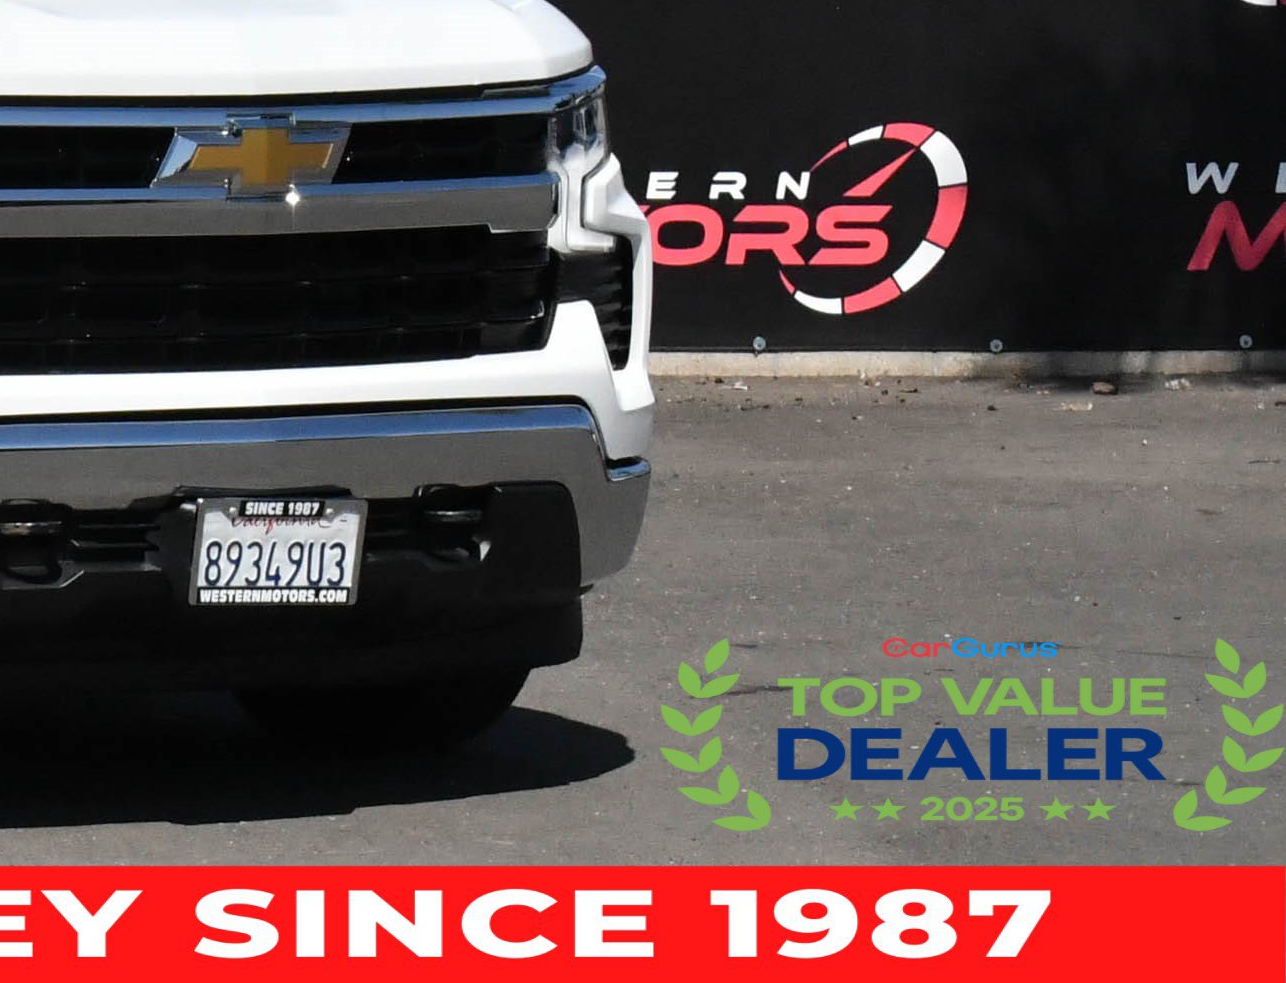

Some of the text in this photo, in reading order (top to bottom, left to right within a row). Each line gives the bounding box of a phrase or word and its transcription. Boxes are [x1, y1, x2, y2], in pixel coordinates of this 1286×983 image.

[244, 501, 320, 516] SINCE 1987
[204, 540, 347, 587] 89349U3
[199, 588, 348, 604] WESTERNMOTORS.COM
